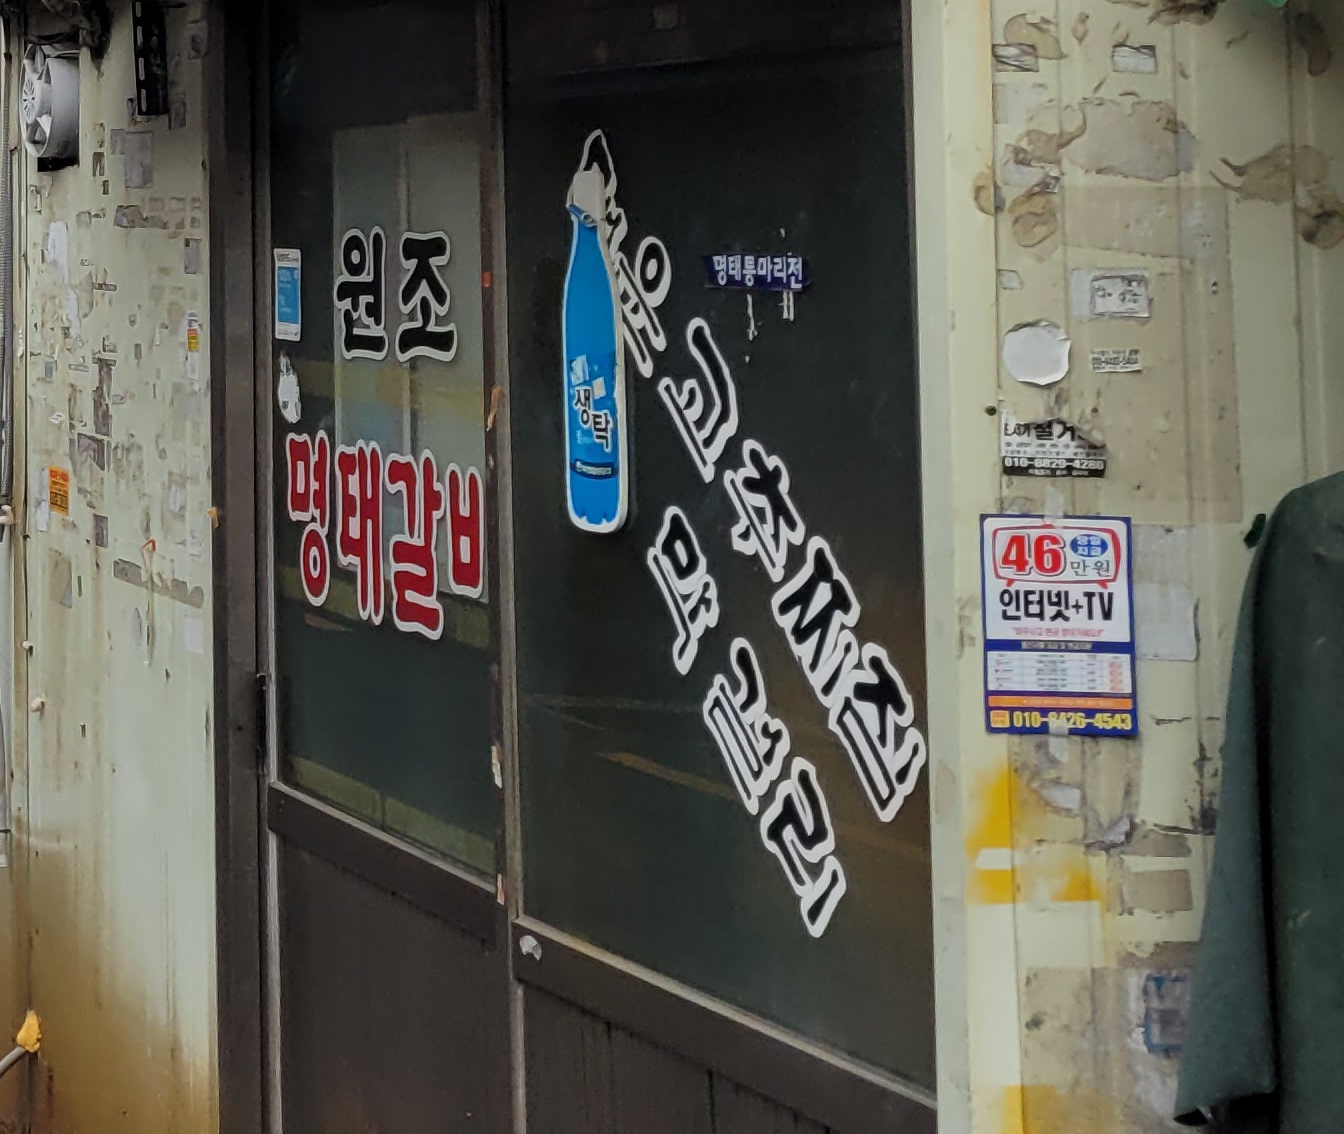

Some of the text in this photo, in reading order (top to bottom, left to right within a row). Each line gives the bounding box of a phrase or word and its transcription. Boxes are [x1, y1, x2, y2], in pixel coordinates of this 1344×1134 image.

[334, 226, 458, 363] 원조
[712, 254, 804, 289] 명태통마리전
[573, 385, 612, 452] 생탁
[285, 429, 486, 642] 명태갈비
[1000, 532, 1066, 577] 46
[1069, 559, 1112, 577] 만원
[999, 588, 1115, 623] 인터넷+TV
[647, 506, 847, 939] 막걸리
